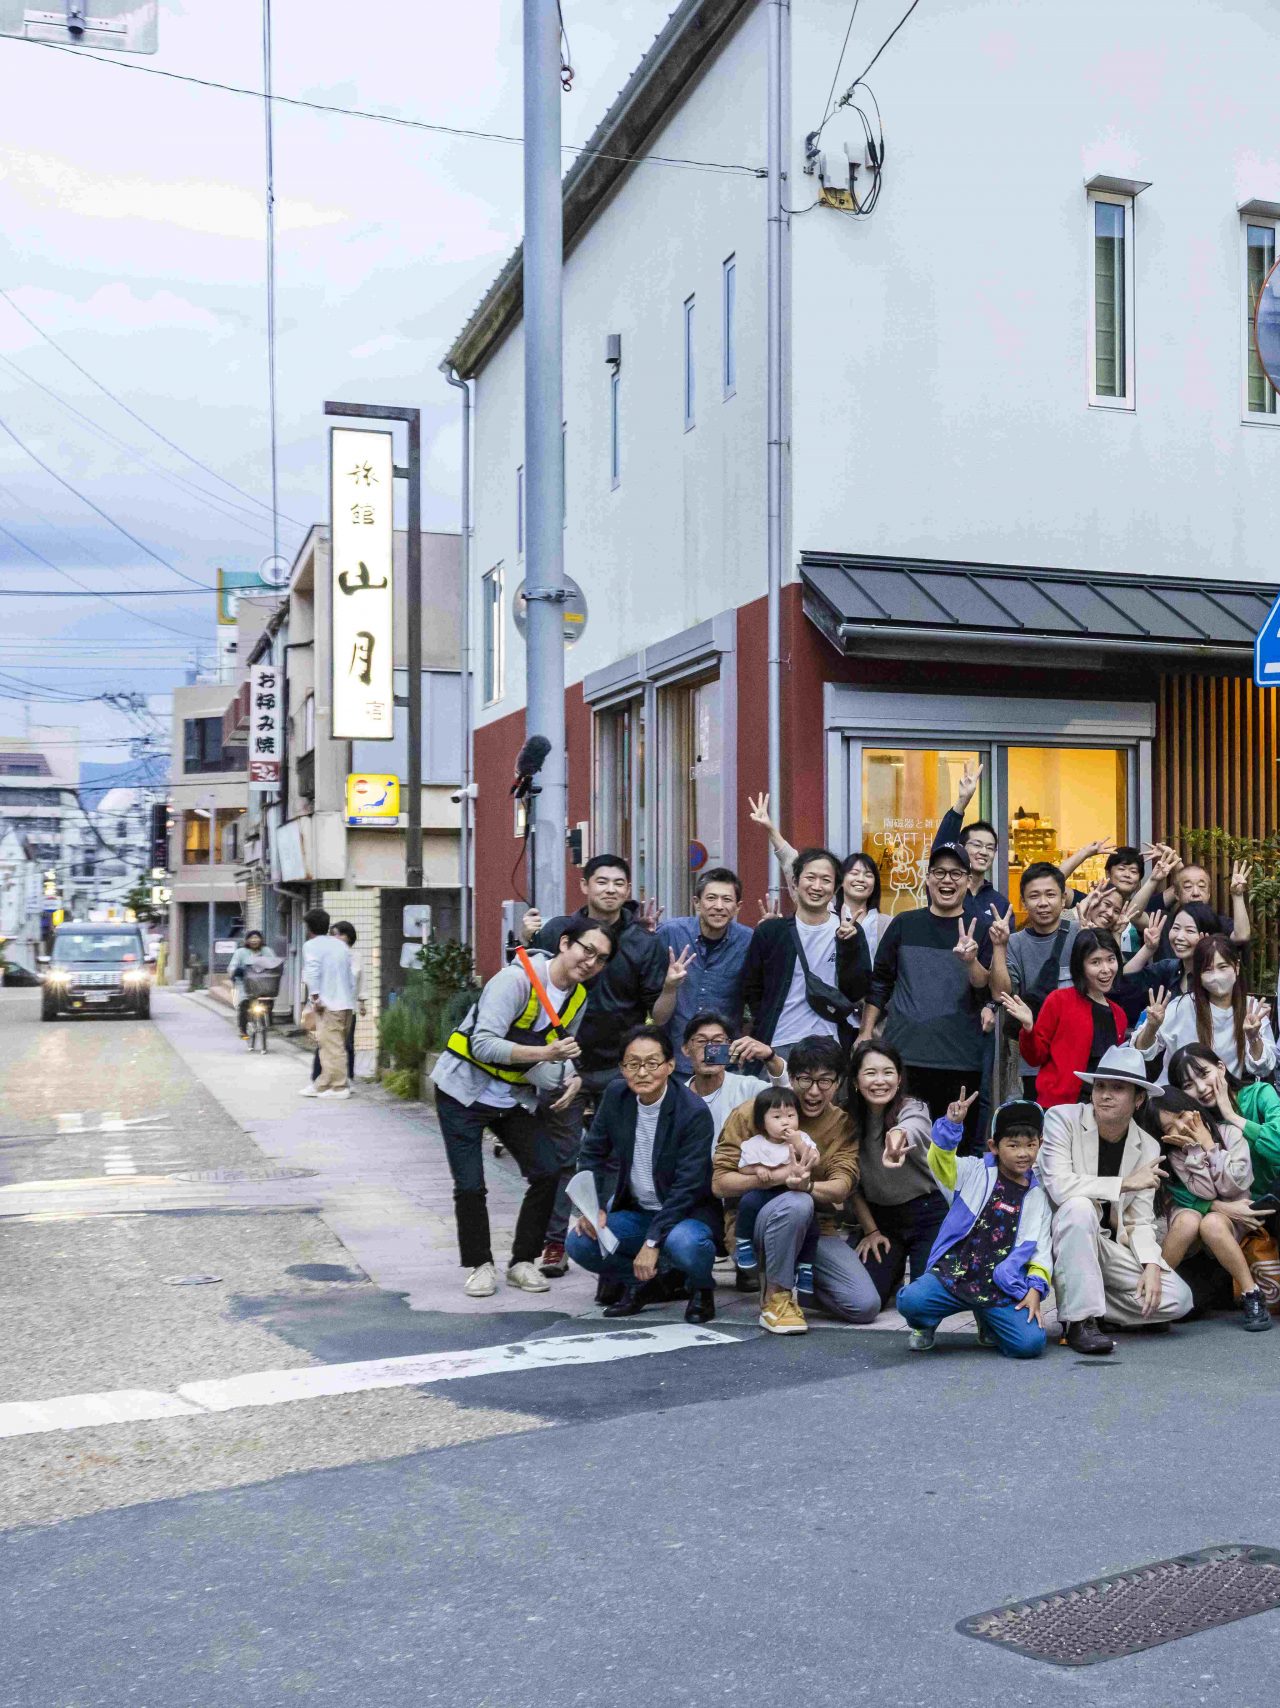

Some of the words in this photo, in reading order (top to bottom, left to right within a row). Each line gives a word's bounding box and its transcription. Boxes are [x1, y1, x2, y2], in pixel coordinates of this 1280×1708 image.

[256, 672, 275, 754] お好み焼
[873, 832, 919, 846] CRAFT
